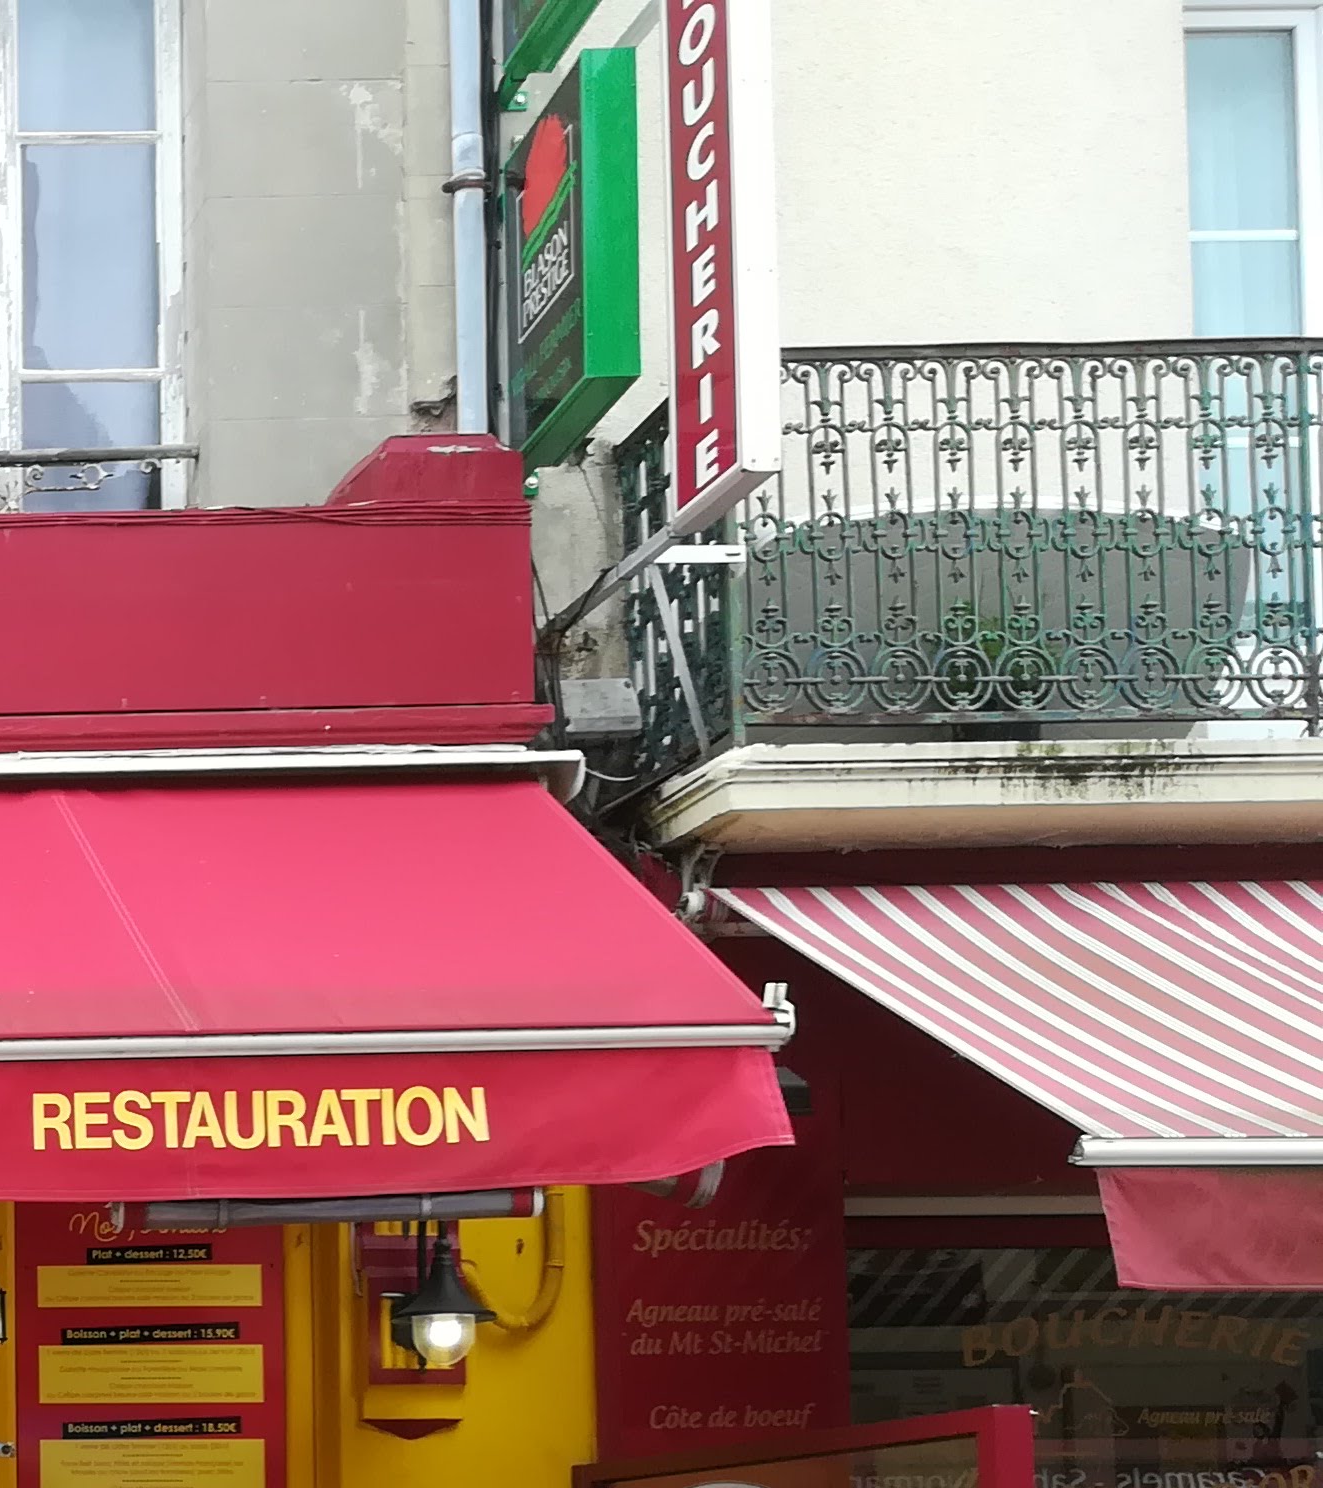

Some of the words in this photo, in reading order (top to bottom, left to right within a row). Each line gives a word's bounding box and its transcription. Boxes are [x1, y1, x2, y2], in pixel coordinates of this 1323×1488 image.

[678, 0, 721, 489] OUCHERIE
[523, 220, 570, 299] BLASON
[521, 248, 570, 329] PRESTIGE
[32, 1086, 490, 1151] RESTAURATION
[92, 1249, 113, 1260] Plat
[124, 1249, 164, 1260] dessert
[625, 1299, 719, 1328] Agneau
[724, 1297, 823, 1327] pré-salé
[66, 1329, 107, 1340] Boisson
[119, 1329, 141, 1342] plat
[152, 1328, 193, 1339] dessert
[630, 1332, 662, 1356] du
[668, 1331, 703, 1355] Mt
[961, 1304, 1311, 1369] BOUCHERIE
[67, 1422, 109, 1434] Boisson
[120, 1422, 142, 1435] plat
[154, 1421, 194, 1433] dessert
[649, 1404, 702, 1430] Côte
[708, 1405, 737, 1429] de
[743, 1403, 816, 1430] boeuf
[1136, 1407, 1200, 1427] Agneau
